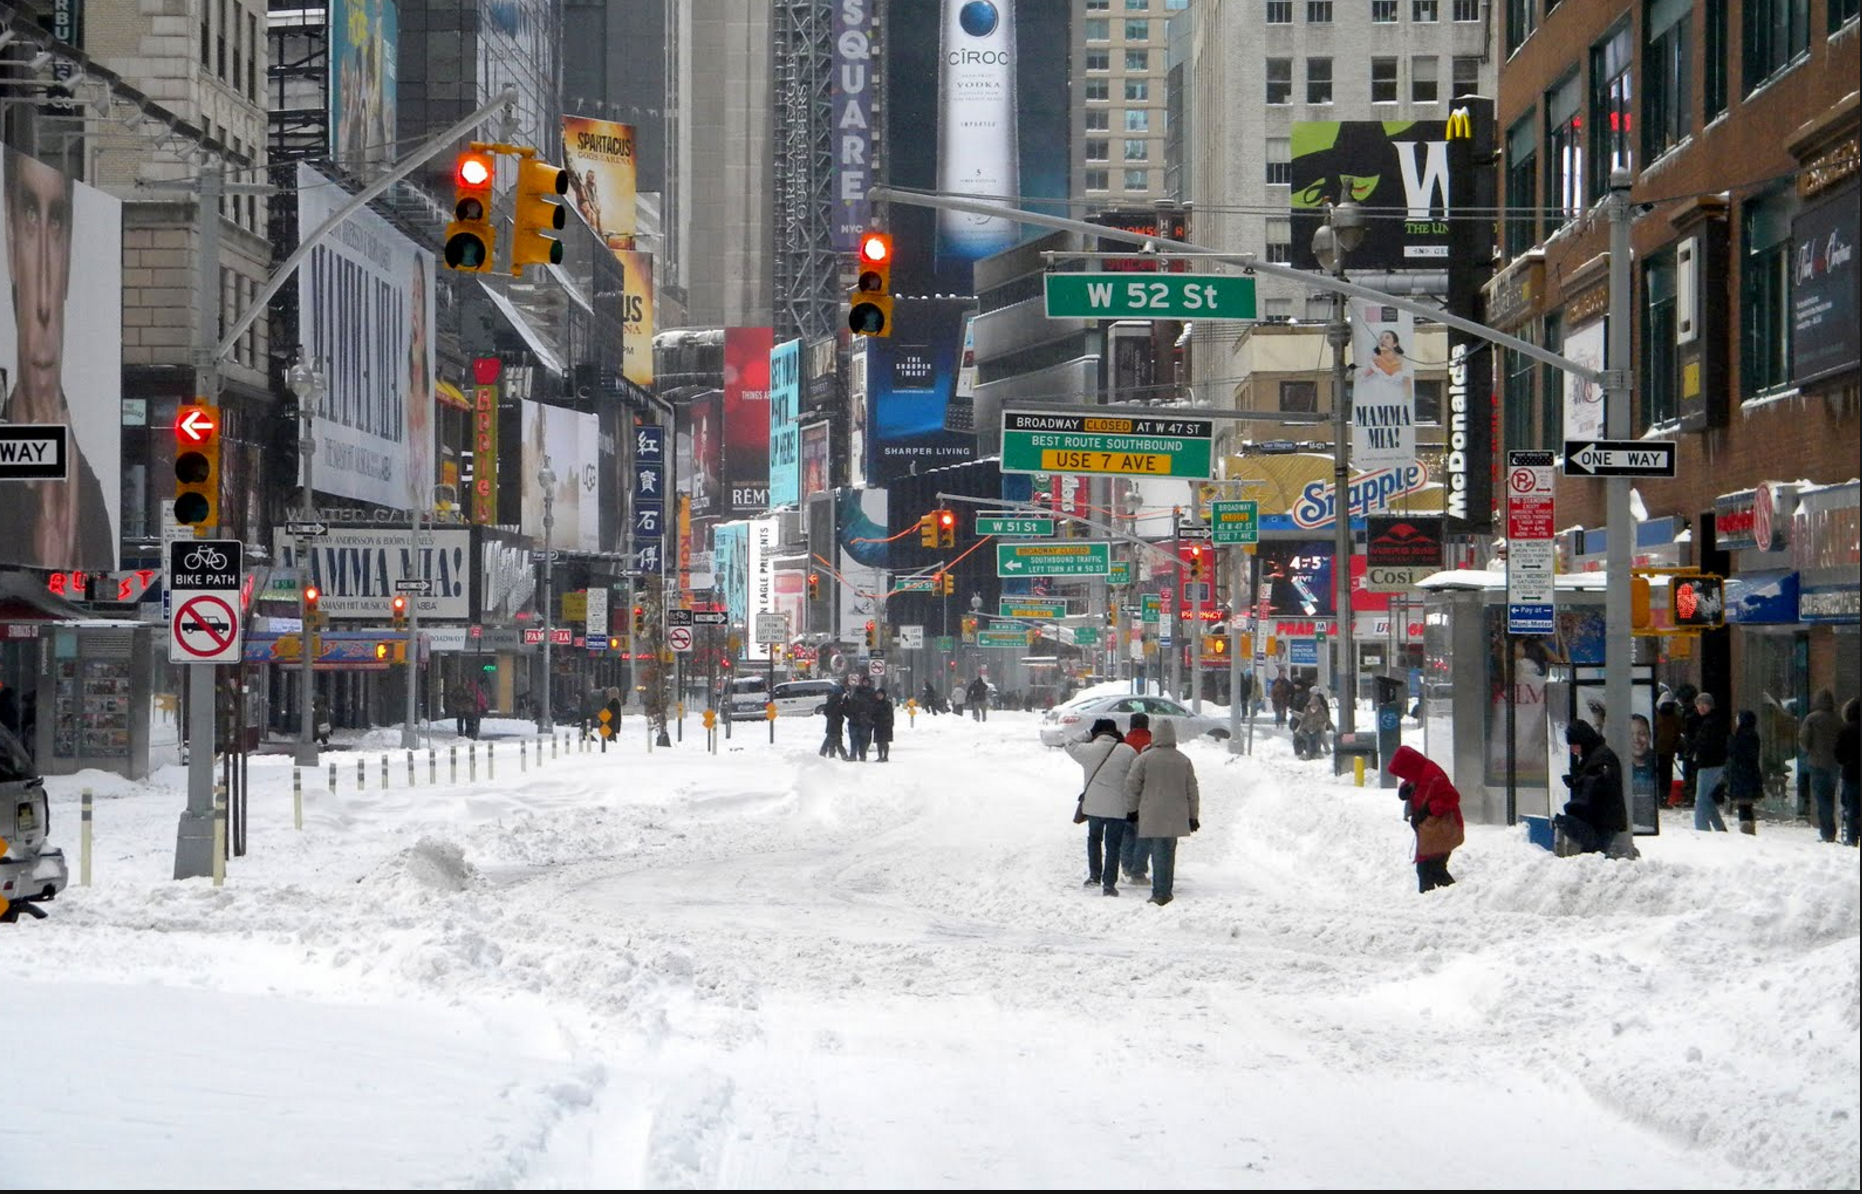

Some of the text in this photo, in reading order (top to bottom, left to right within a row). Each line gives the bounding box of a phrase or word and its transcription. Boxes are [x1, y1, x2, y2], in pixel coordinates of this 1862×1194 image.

[948, 48, 1008, 66] CÎROC
[838, 0, 872, 200] SQUARE
[577, 132, 631, 157] SPARTACUS
[797, 84, 808, 219] OUTFITTERS
[786, 53, 796, 253] AMERICAN EAGLE
[841, 224, 864, 233] NYC
[1405, 223, 1430, 234] THE
[1087, 284, 1218, 308] W 52 St
[741, 390, 762, 400] THINGS
[1356, 405, 1411, 427] MAMMA
[1016, 416, 1200, 434] BROADWAY CLOSED AT W 47 ST
[1032, 436, 1183, 451] BEST ROUTE SOUTHBOUND
[1368, 427, 1400, 449] MIA!
[0, 443, 48, 462] WAY
[884, 447, 970, 455] SHARPER LIVING
[1581, 452, 1661, 466] ONE WAY
[1057, 453, 1156, 471] USE 7 AVE
[993, 522, 1037, 531] W 51 St
[335, 536, 375, 546] ANDERSSON
[1289, 555, 1322, 570] 4 5
[175, 574, 236, 585] BIKE PATH
[1370, 568, 1415, 584] Così
[760, 577, 769, 602] EAGLE
[321, 601, 344, 610] SMASH
[347, 601, 359, 610] HIT
[361, 601, 390, 610] MUSICAL
[1521, 606, 1533, 615] Pay
